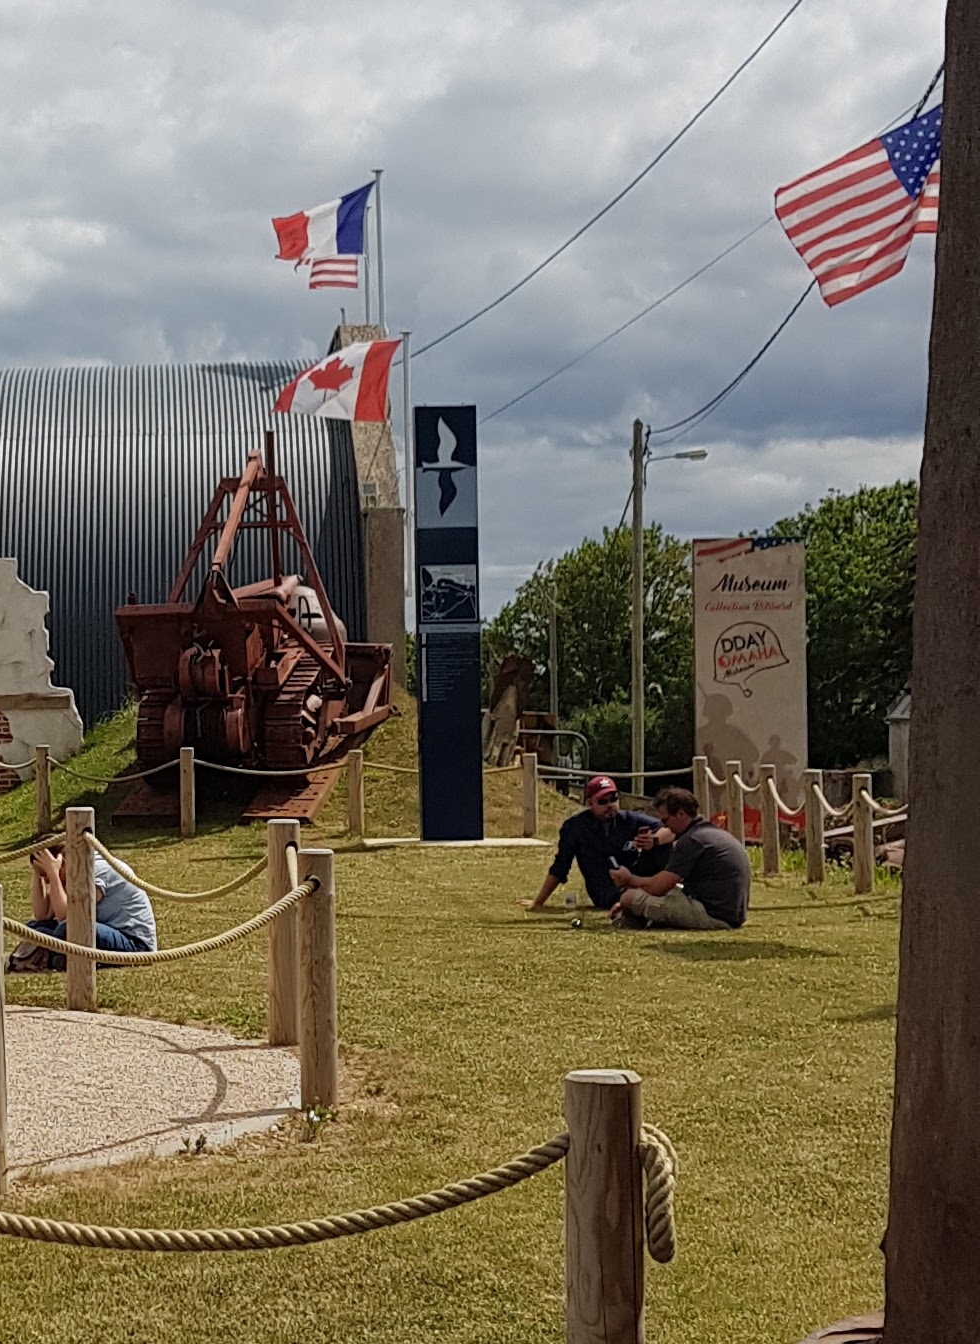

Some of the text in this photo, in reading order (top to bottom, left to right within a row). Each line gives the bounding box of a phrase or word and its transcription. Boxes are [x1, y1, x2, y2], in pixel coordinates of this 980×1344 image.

[711, 573, 790, 592] Museum
[721, 630, 766, 653] DDAY
[718, 646, 779, 668] OMAHA
